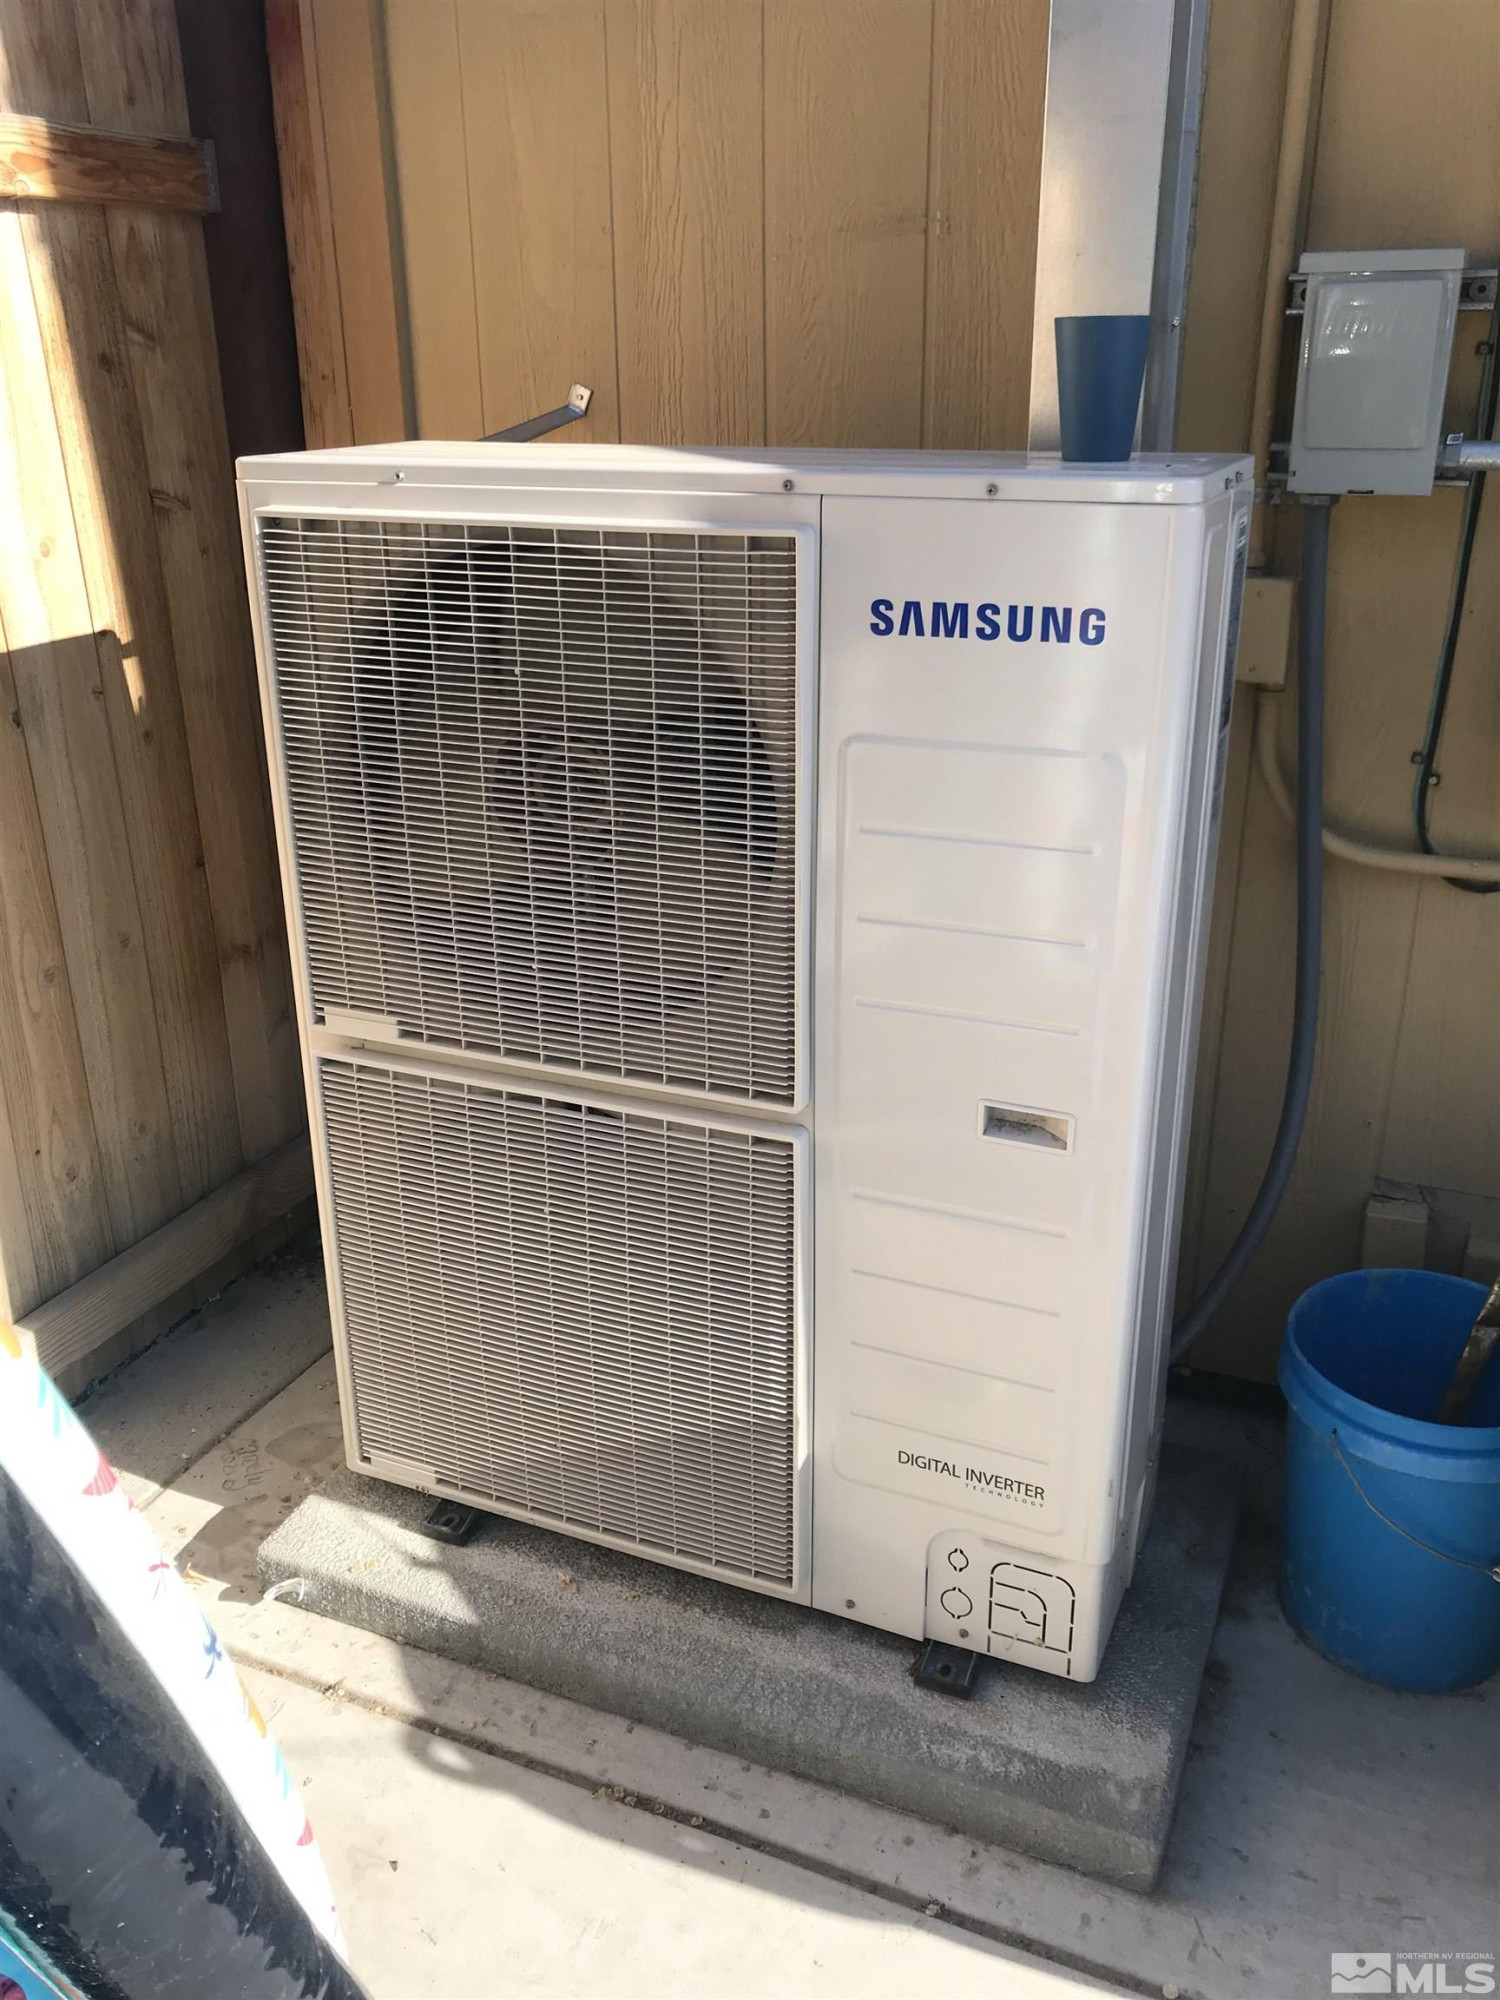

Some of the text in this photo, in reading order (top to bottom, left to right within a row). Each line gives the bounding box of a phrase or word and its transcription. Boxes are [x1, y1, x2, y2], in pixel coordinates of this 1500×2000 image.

[869, 598, 1106, 646] SAMSUNG
[898, 1450, 1045, 1501] DIGITAL INVERTER
[965, 1484, 1044, 1508] TECHNOLOGY
